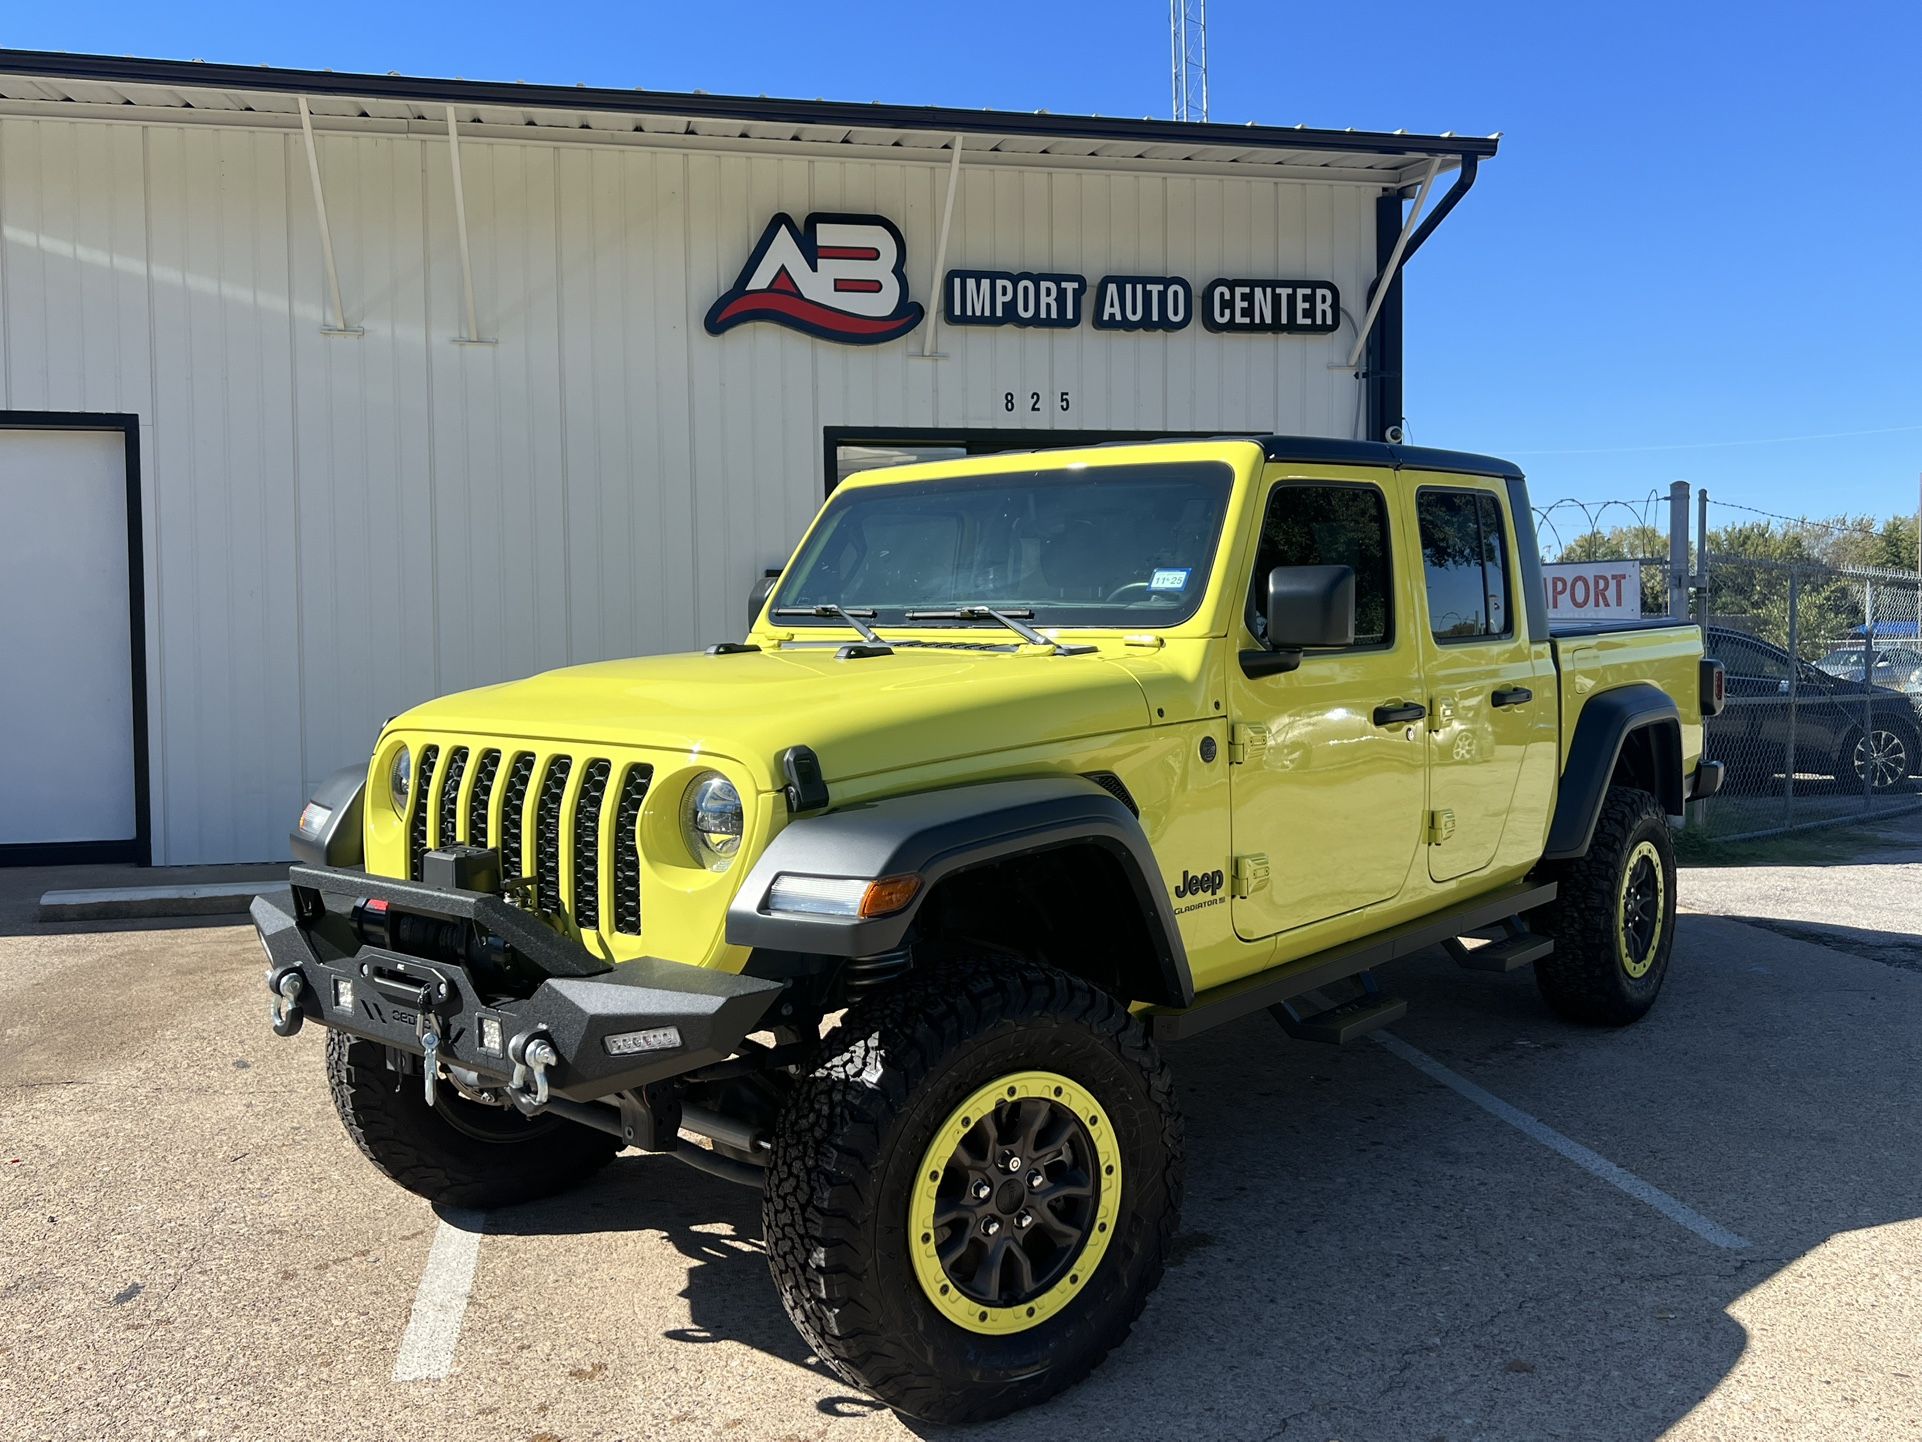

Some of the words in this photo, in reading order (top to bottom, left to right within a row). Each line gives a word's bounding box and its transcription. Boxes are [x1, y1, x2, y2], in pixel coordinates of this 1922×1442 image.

[746, 223, 900, 317] AB
[953, 277, 1079, 320] IMPORT
[1102, 282, 1185, 323] AUTO
[1213, 286, 1333, 326] CENTER
[1543, 573, 1627, 610] PORT
[1174, 869, 1224, 899] Jeep
[1173, 898, 1218, 915] GLADIATOR
